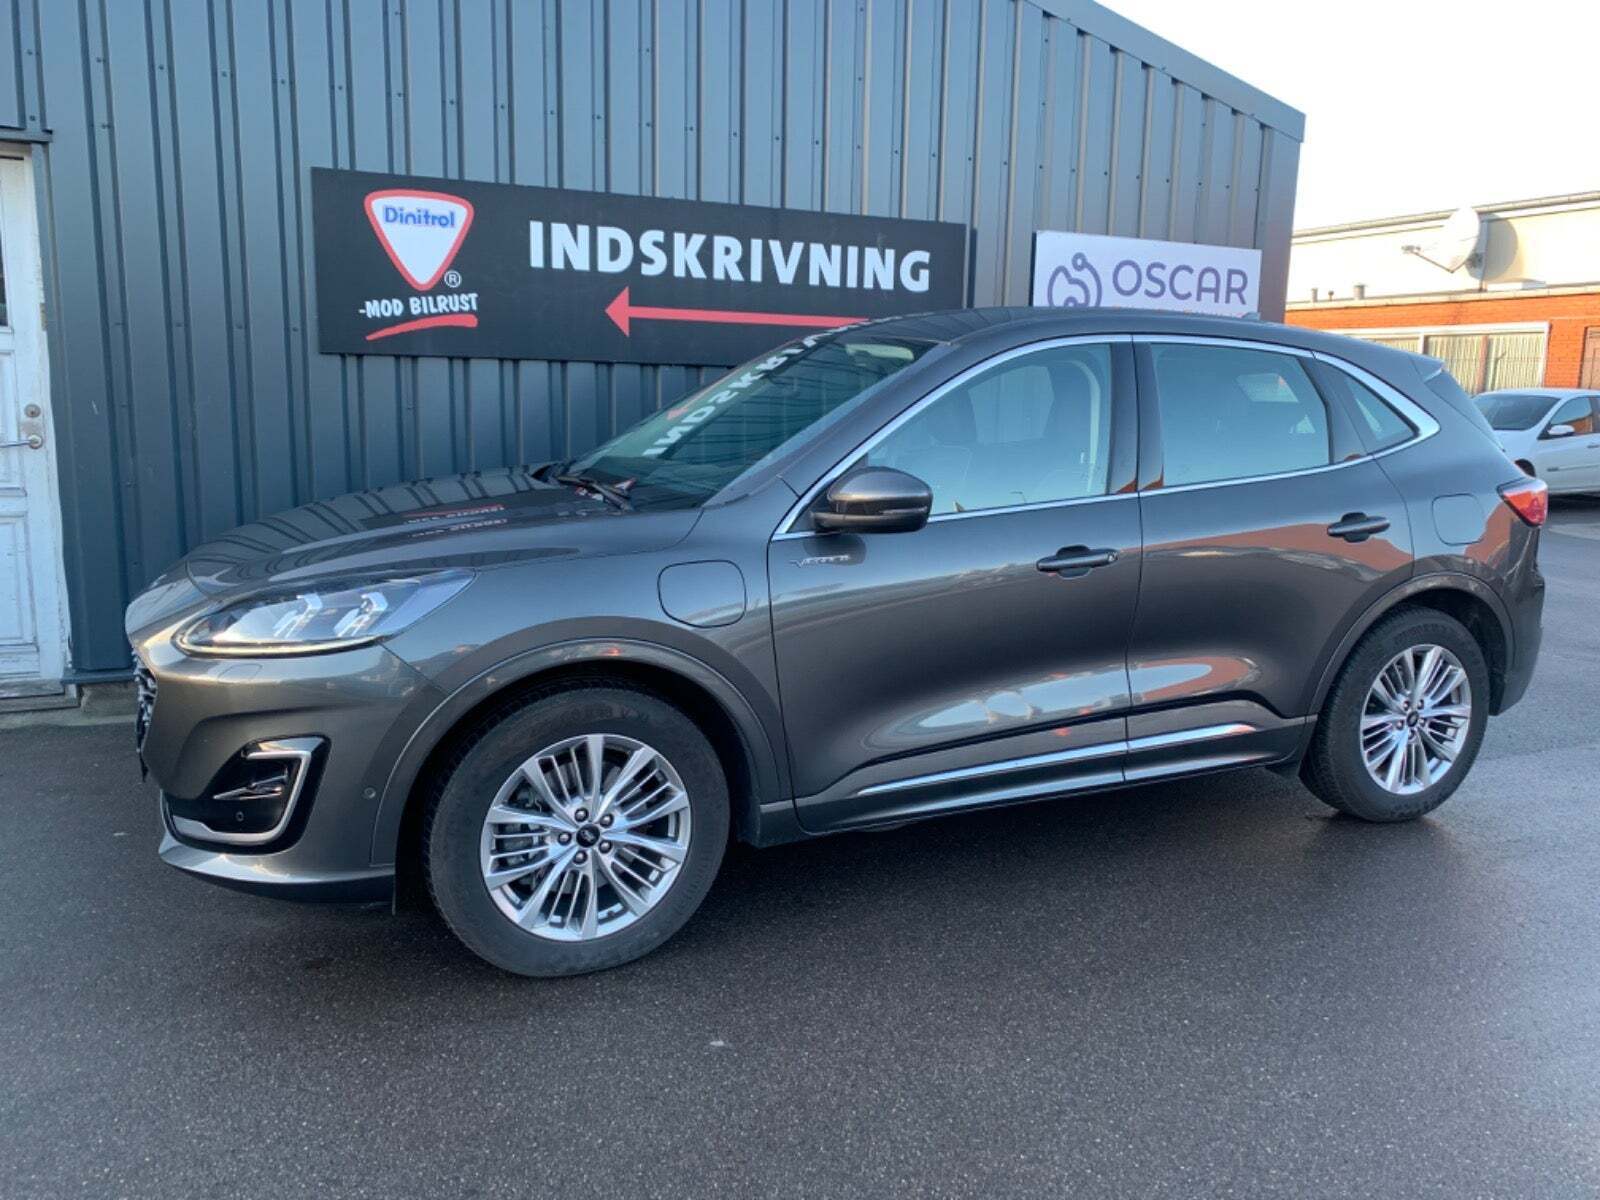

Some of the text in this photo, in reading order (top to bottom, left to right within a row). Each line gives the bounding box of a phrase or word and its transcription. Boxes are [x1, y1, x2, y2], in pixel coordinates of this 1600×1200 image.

[384, 205, 455, 227] Dinitrol
[529, 220, 930, 292] INDSKRIVNING
[1112, 260, 1248, 304] OSCAR
[409, 293, 478, 315] BILRUST
